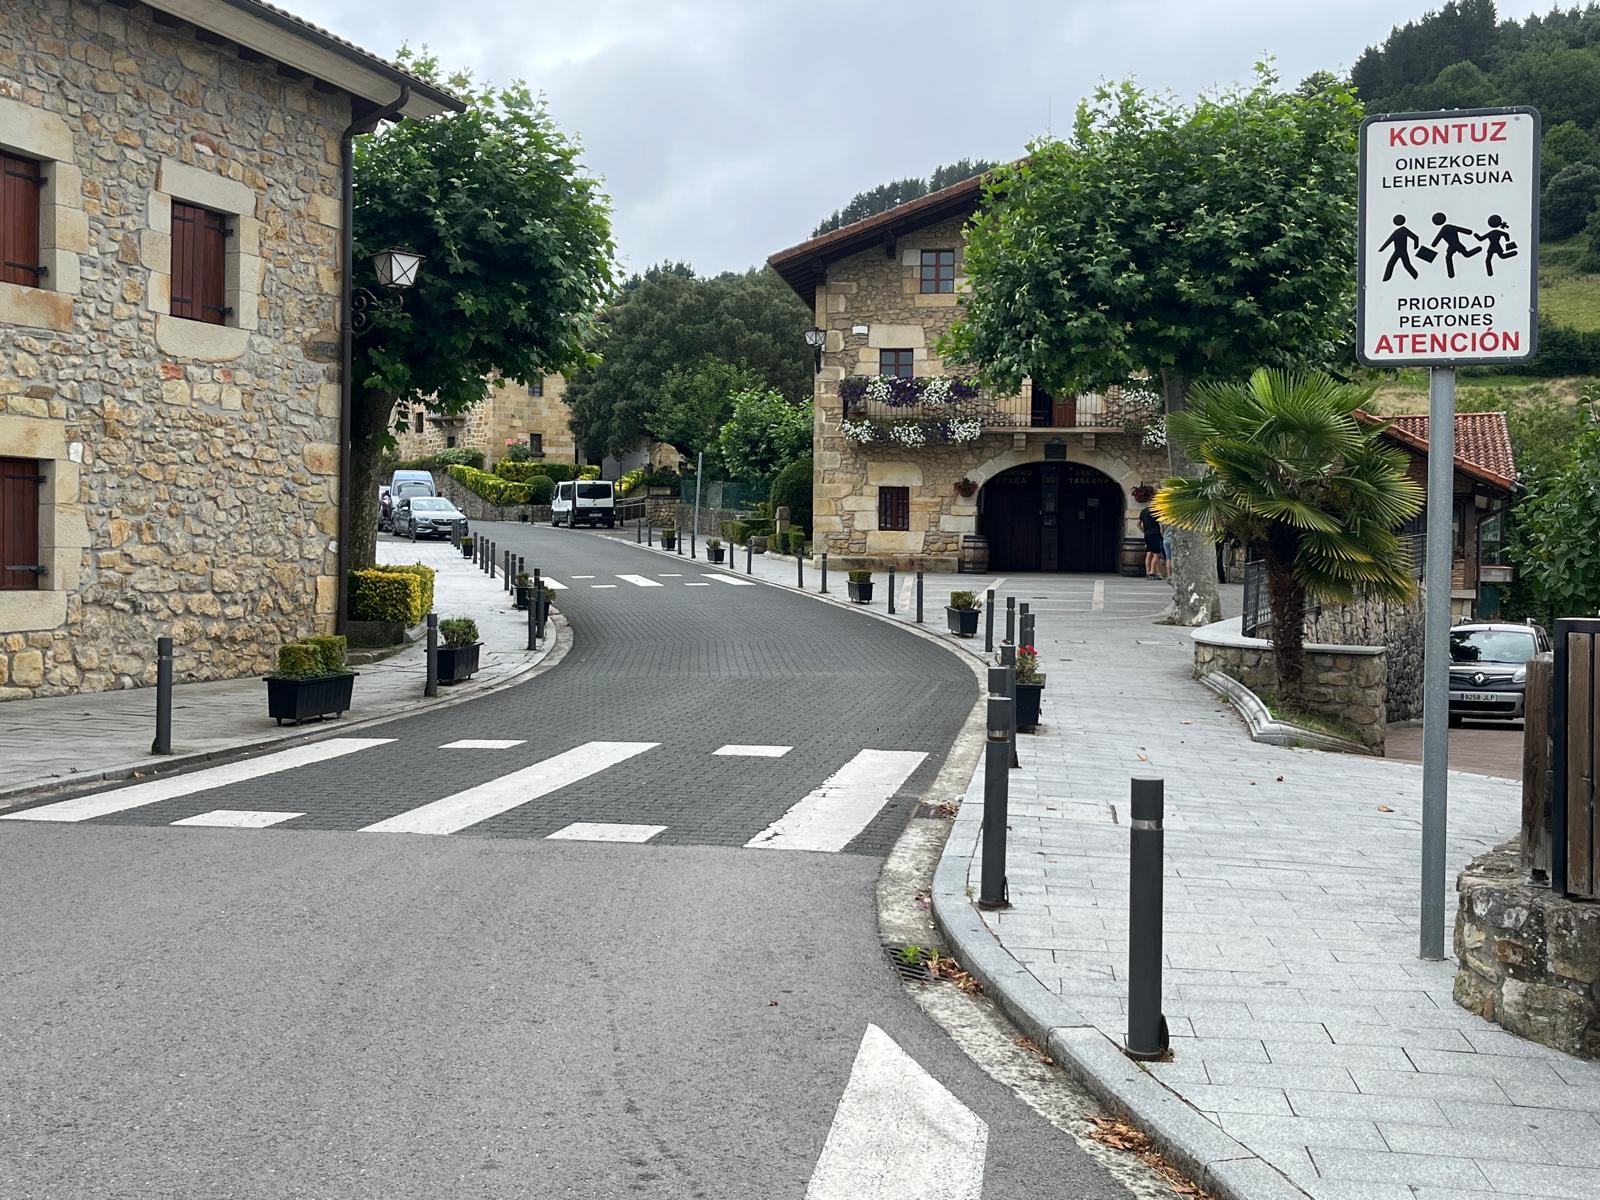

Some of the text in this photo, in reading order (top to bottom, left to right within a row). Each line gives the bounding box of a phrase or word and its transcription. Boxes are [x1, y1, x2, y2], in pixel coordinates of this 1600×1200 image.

[1389, 121, 1507, 147] KONTUZ
[1395, 153, 1499, 170] OINEZKOEN
[1382, 170, 1513, 188] LEHENTASUNA
[1397, 295, 1495, 311] PRIORIDAD
[1399, 313, 1493, 328] PEATONES
[1374, 327, 1520, 354] ATENCIÓN
[1068, 476, 1109, 484] TABERNA
